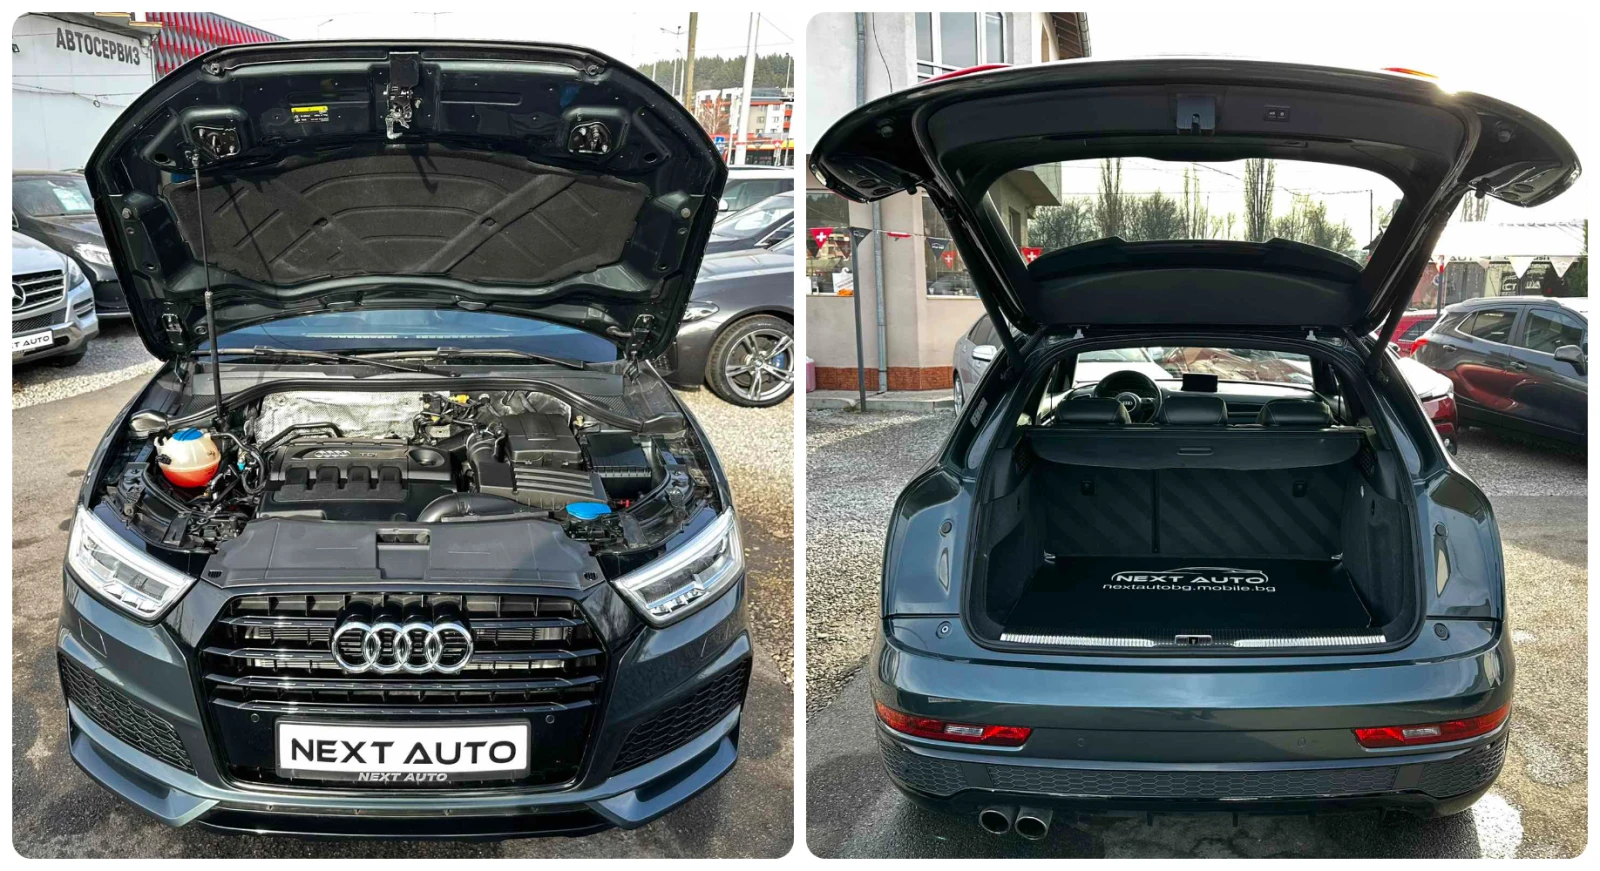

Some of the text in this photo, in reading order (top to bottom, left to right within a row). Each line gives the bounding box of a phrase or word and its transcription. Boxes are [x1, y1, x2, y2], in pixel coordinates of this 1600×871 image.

[56, 27, 140, 66] АВТОСЕРВИЗ
[23, 335, 50, 347] AUTO
[1116, 575, 1265, 584] NEXT AUTO
[1102, 584, 1276, 593] nextautobg.mobile.bg
[291, 737, 516, 765] NEXT AUTO
[357, 772, 448, 782] NEXT AUTO
